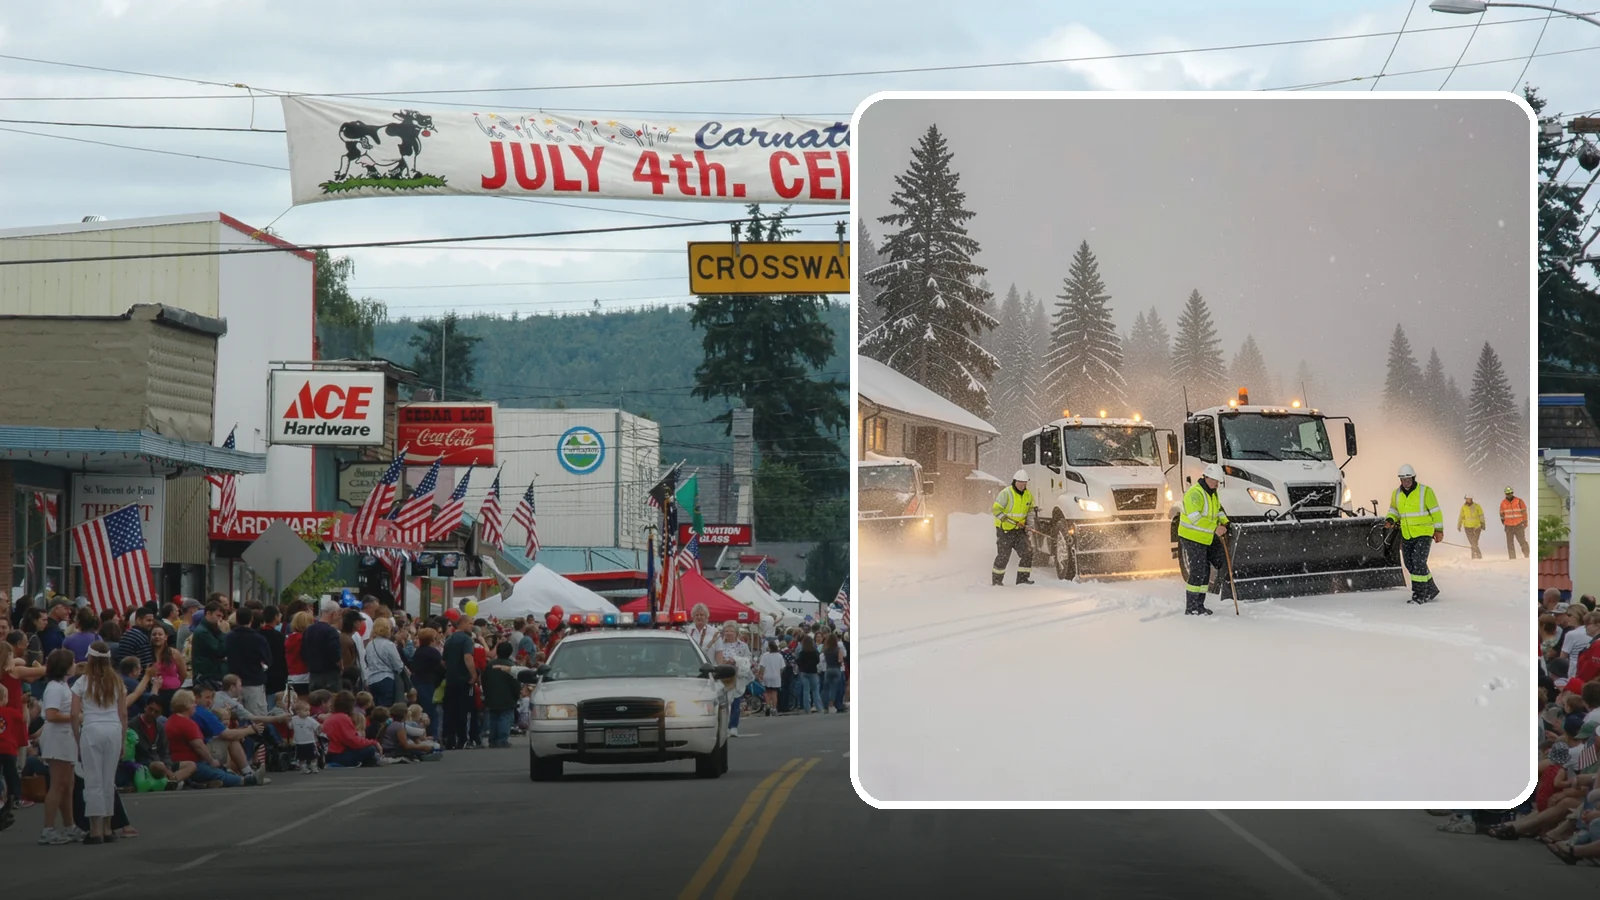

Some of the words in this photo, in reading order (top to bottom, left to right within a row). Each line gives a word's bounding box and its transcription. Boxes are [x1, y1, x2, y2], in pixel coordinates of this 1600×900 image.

[694, 121, 850, 150] Carnat
[481, 141, 605, 193] JULY
[632, 150, 746, 198] 4th.
[697, 253, 850, 280] CROSSWA
[283, 380, 374, 420] ACE
[406, 409, 453, 422] CEDAR
[283, 421, 371, 436] Hardware
[354, 467, 385, 480] Simpl
[95, 485, 123, 495] Vincent
[126, 485, 135, 494] de
[138, 486, 155, 496] Paul
[688, 526, 741, 535] CRNATION
[699, 535, 730, 543] GLASS
